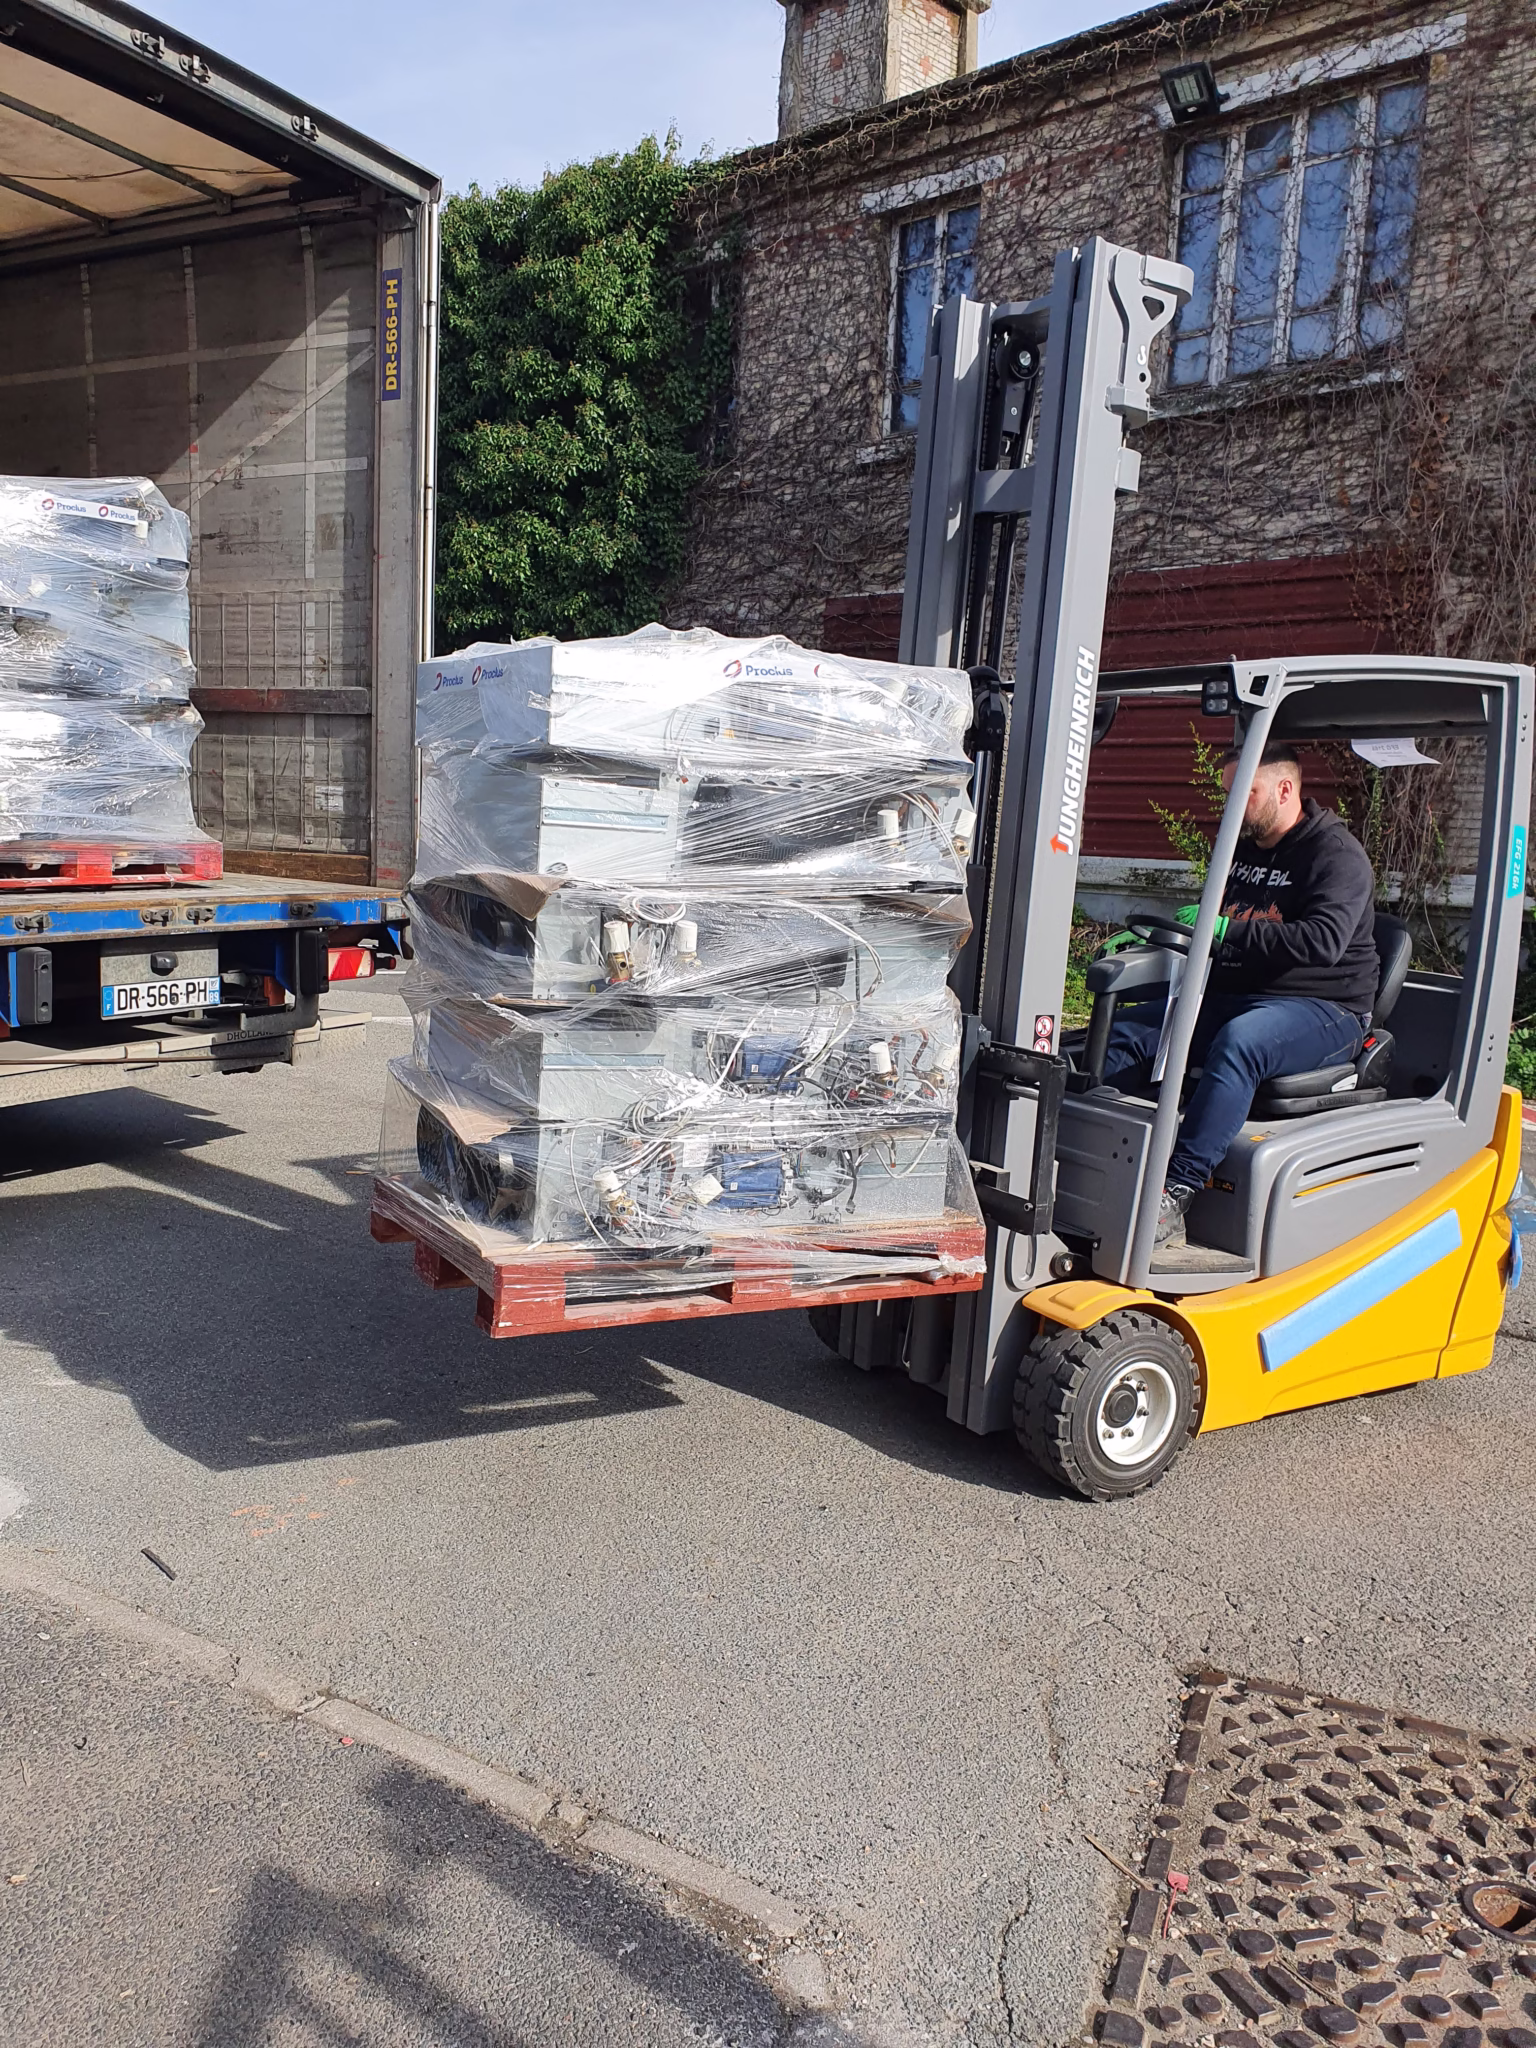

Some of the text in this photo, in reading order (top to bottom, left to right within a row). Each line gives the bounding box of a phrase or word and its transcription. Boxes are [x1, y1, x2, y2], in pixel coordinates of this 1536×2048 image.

[386, 279, 398, 391] DR-566-PH
[1050, 645, 1096, 855] JUNGHEINRICH
[1515, 838, 1523, 860] EFG
